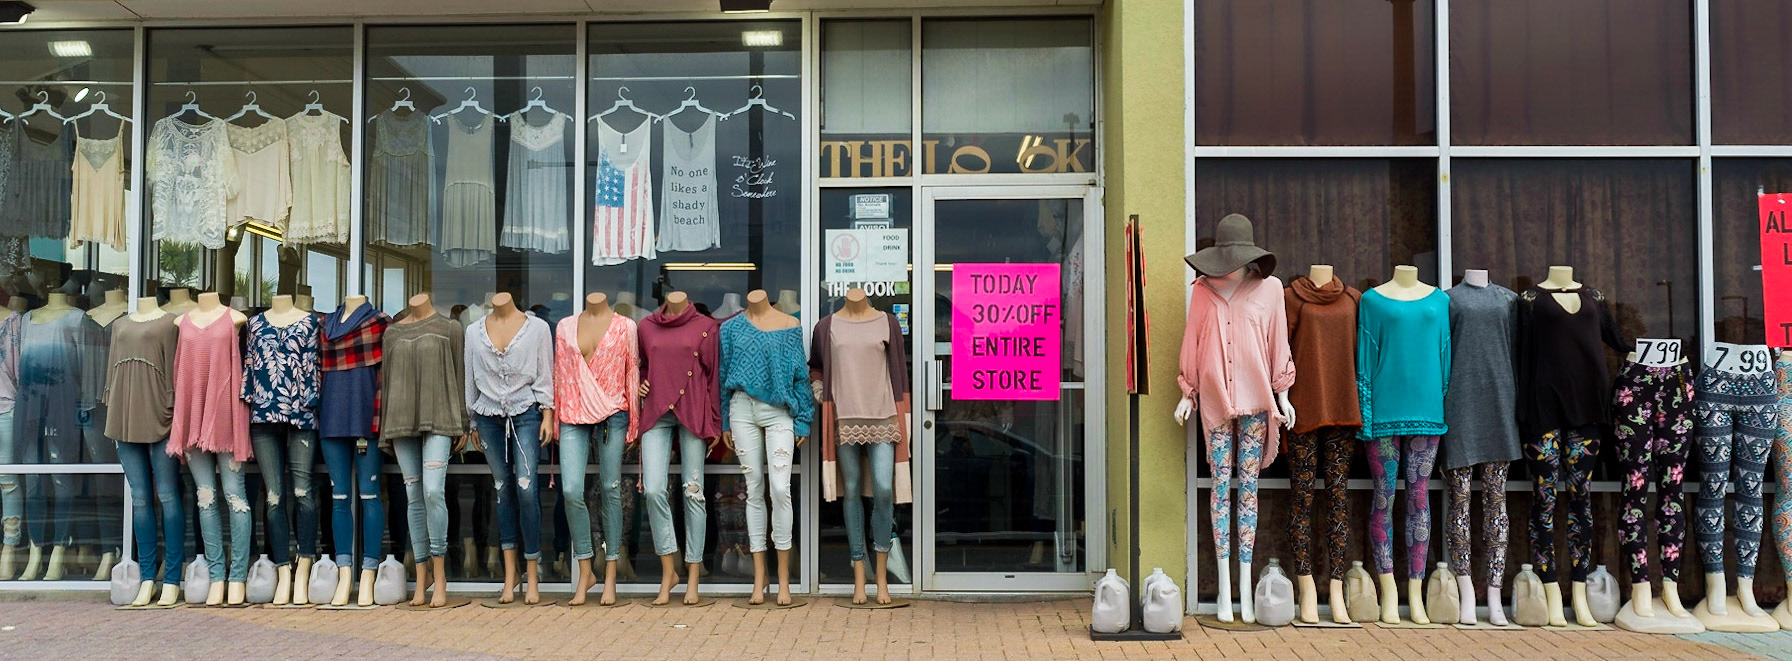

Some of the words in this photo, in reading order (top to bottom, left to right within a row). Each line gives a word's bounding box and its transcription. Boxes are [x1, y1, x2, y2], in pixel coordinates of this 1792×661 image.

[820, 140, 912, 178] THE
[671, 166, 684, 176] No
[689, 167, 708, 178] one
[671, 182, 697, 194] likes
[672, 199, 705, 210] shady
[673, 215, 705, 226] beach
[970, 275, 1038, 294] TODAY
[972, 337, 1046, 356] ENTIRE
[1637, 341, 1680, 364] 7.99
[1713, 346, 1768, 373] 7.99
[972, 370, 1042, 390] STORE
